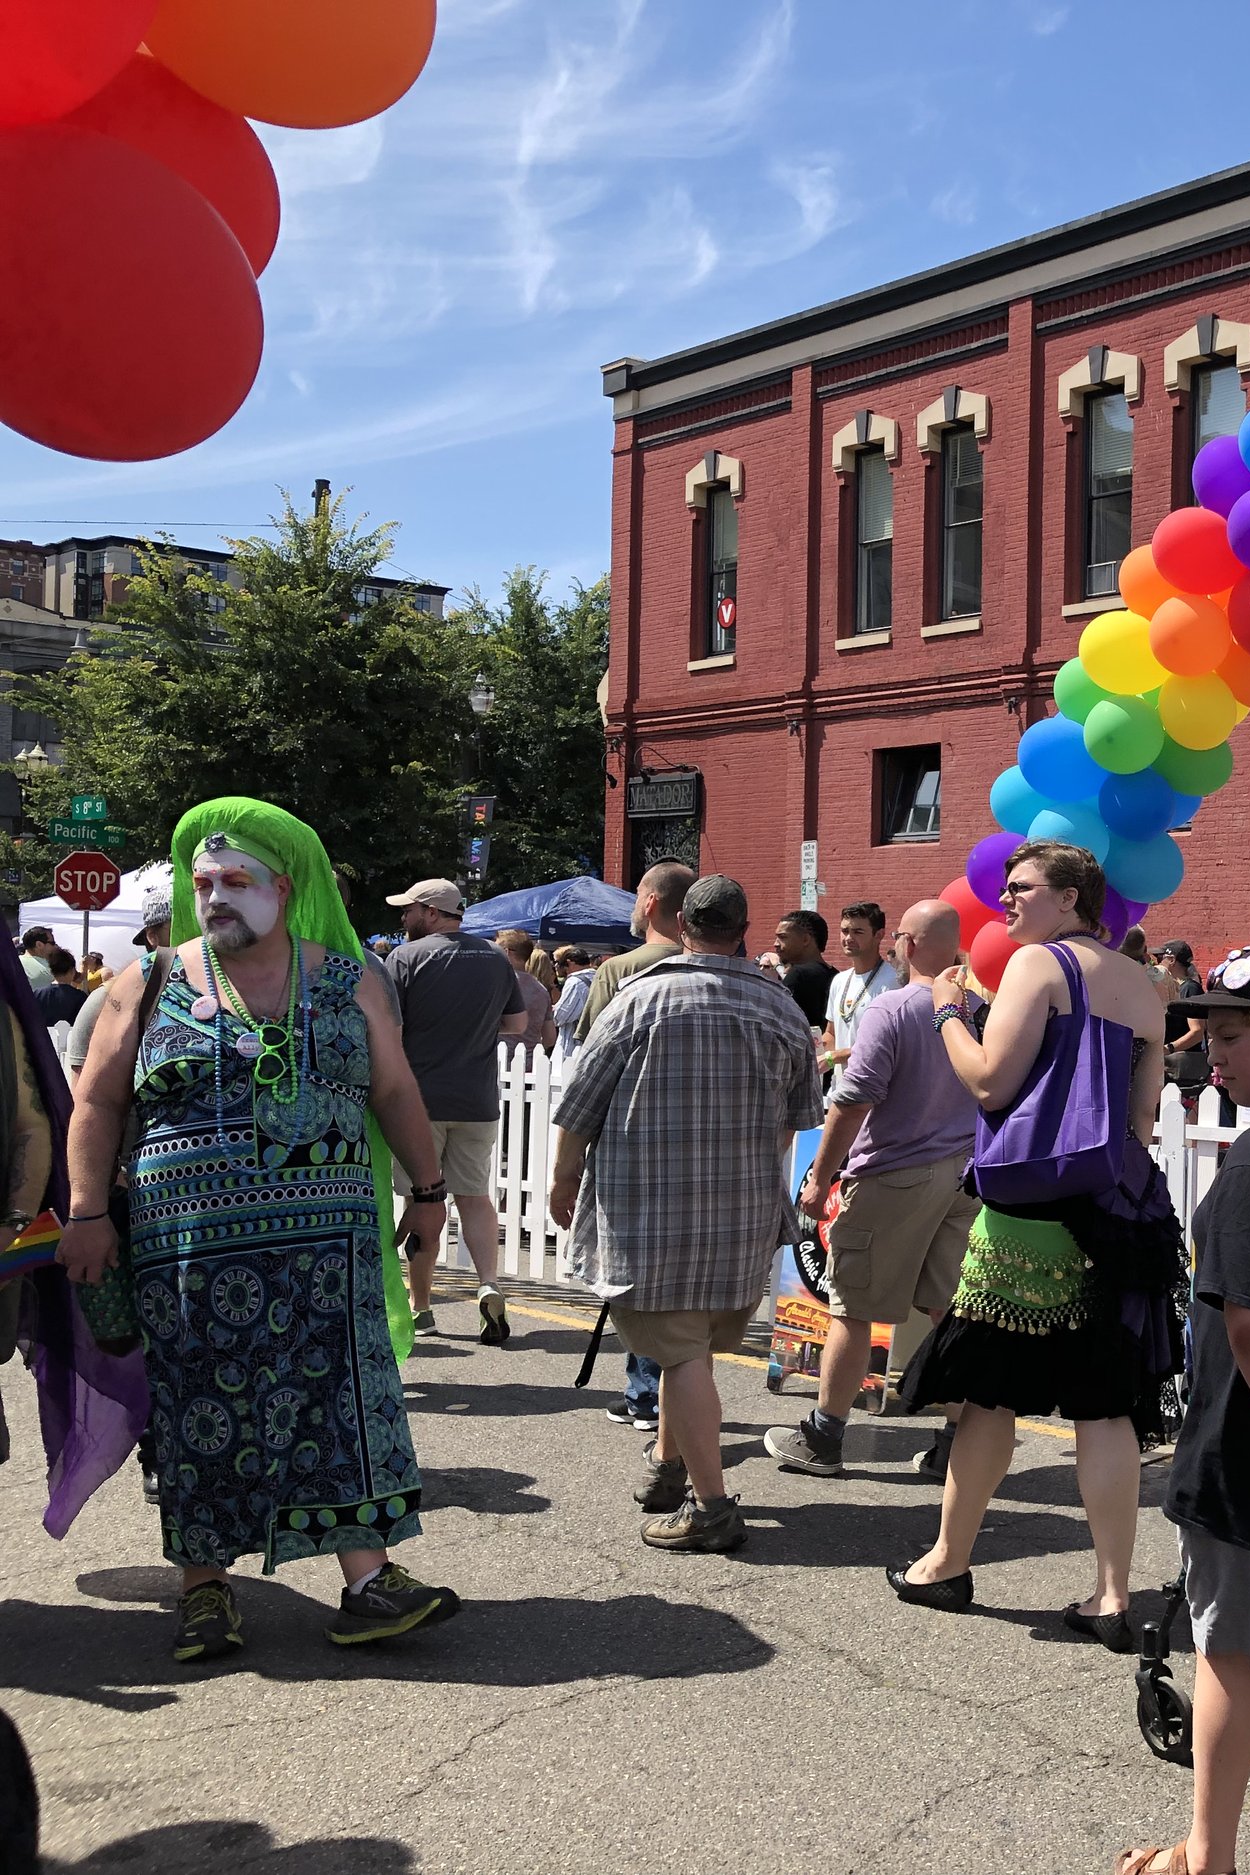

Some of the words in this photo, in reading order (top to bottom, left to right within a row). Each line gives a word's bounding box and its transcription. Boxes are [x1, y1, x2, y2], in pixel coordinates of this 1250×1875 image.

[630, 784, 690, 807] MATADOR
[75, 803, 80, 814] S
[95, 802, 103, 812] ST
[54, 823, 98, 840] Pacific
[108, 835, 120, 844] 100
[60, 869, 116, 893] STOP
[799, 1240, 820, 1282] Classic
